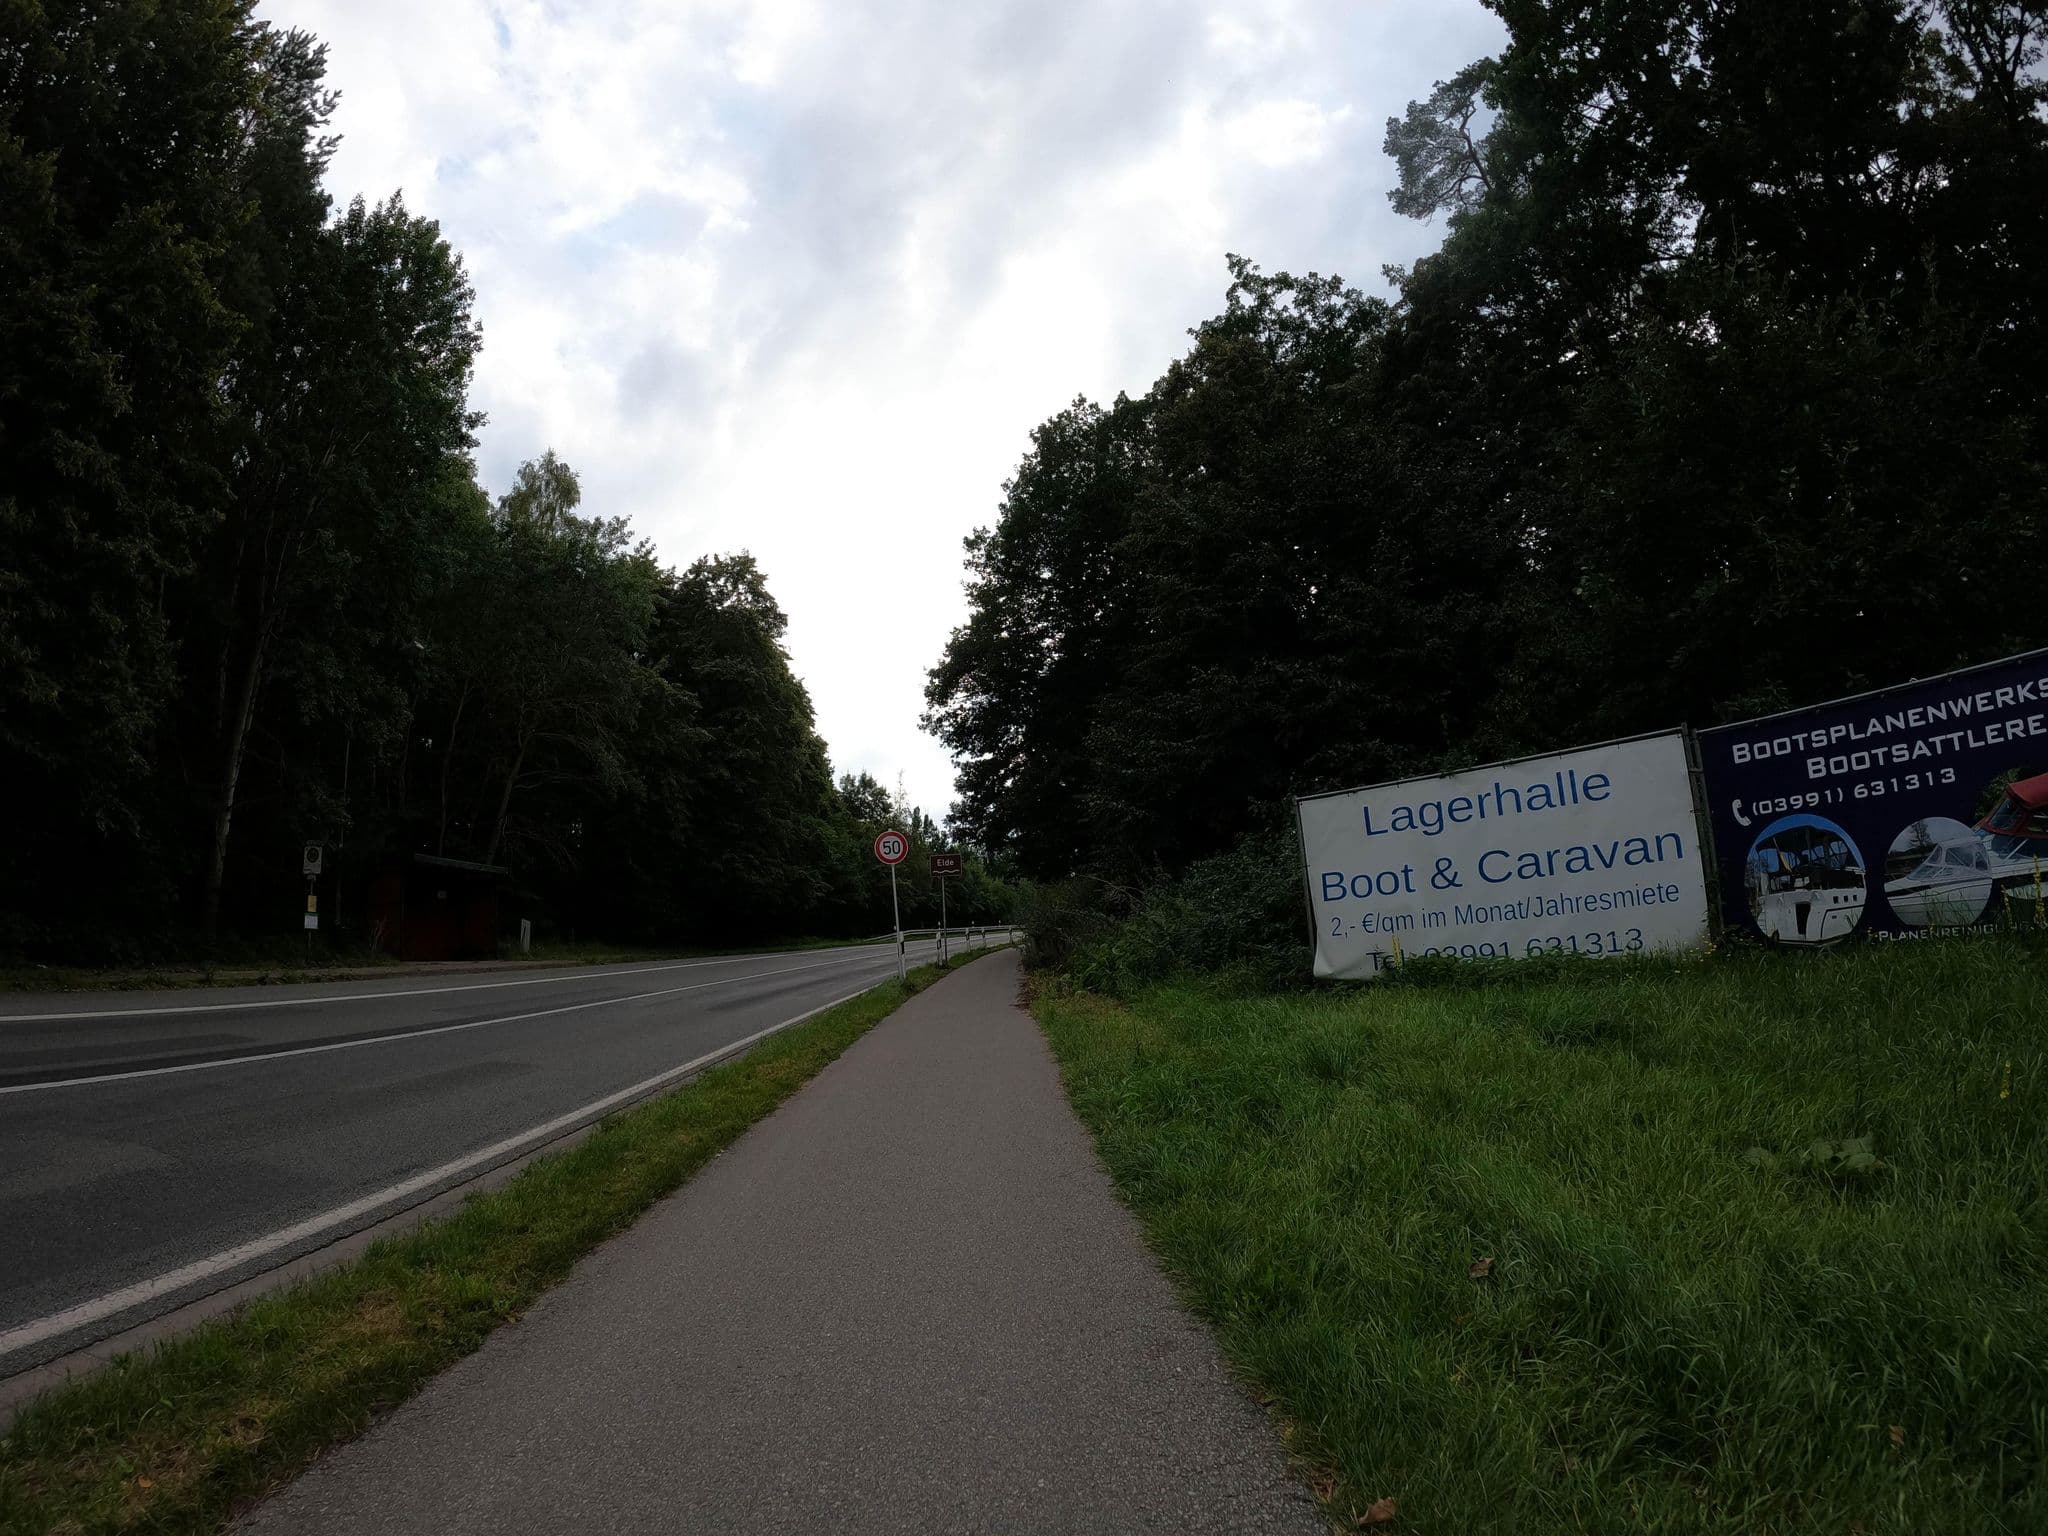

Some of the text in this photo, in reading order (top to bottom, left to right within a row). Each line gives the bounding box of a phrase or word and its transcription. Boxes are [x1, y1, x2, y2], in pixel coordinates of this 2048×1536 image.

[1363, 769, 1611, 837] Lagerhalle
[1752, 767, 1957, 817] (03991) 631313
[883, 841, 901, 854] 50
[937, 859, 954, 867] Elde
[1321, 831, 1684, 902] Boot & Caravan
[1423, 907, 1447, 929] im
[1455, 881, 1681, 926] Monat/Jahresmiete
